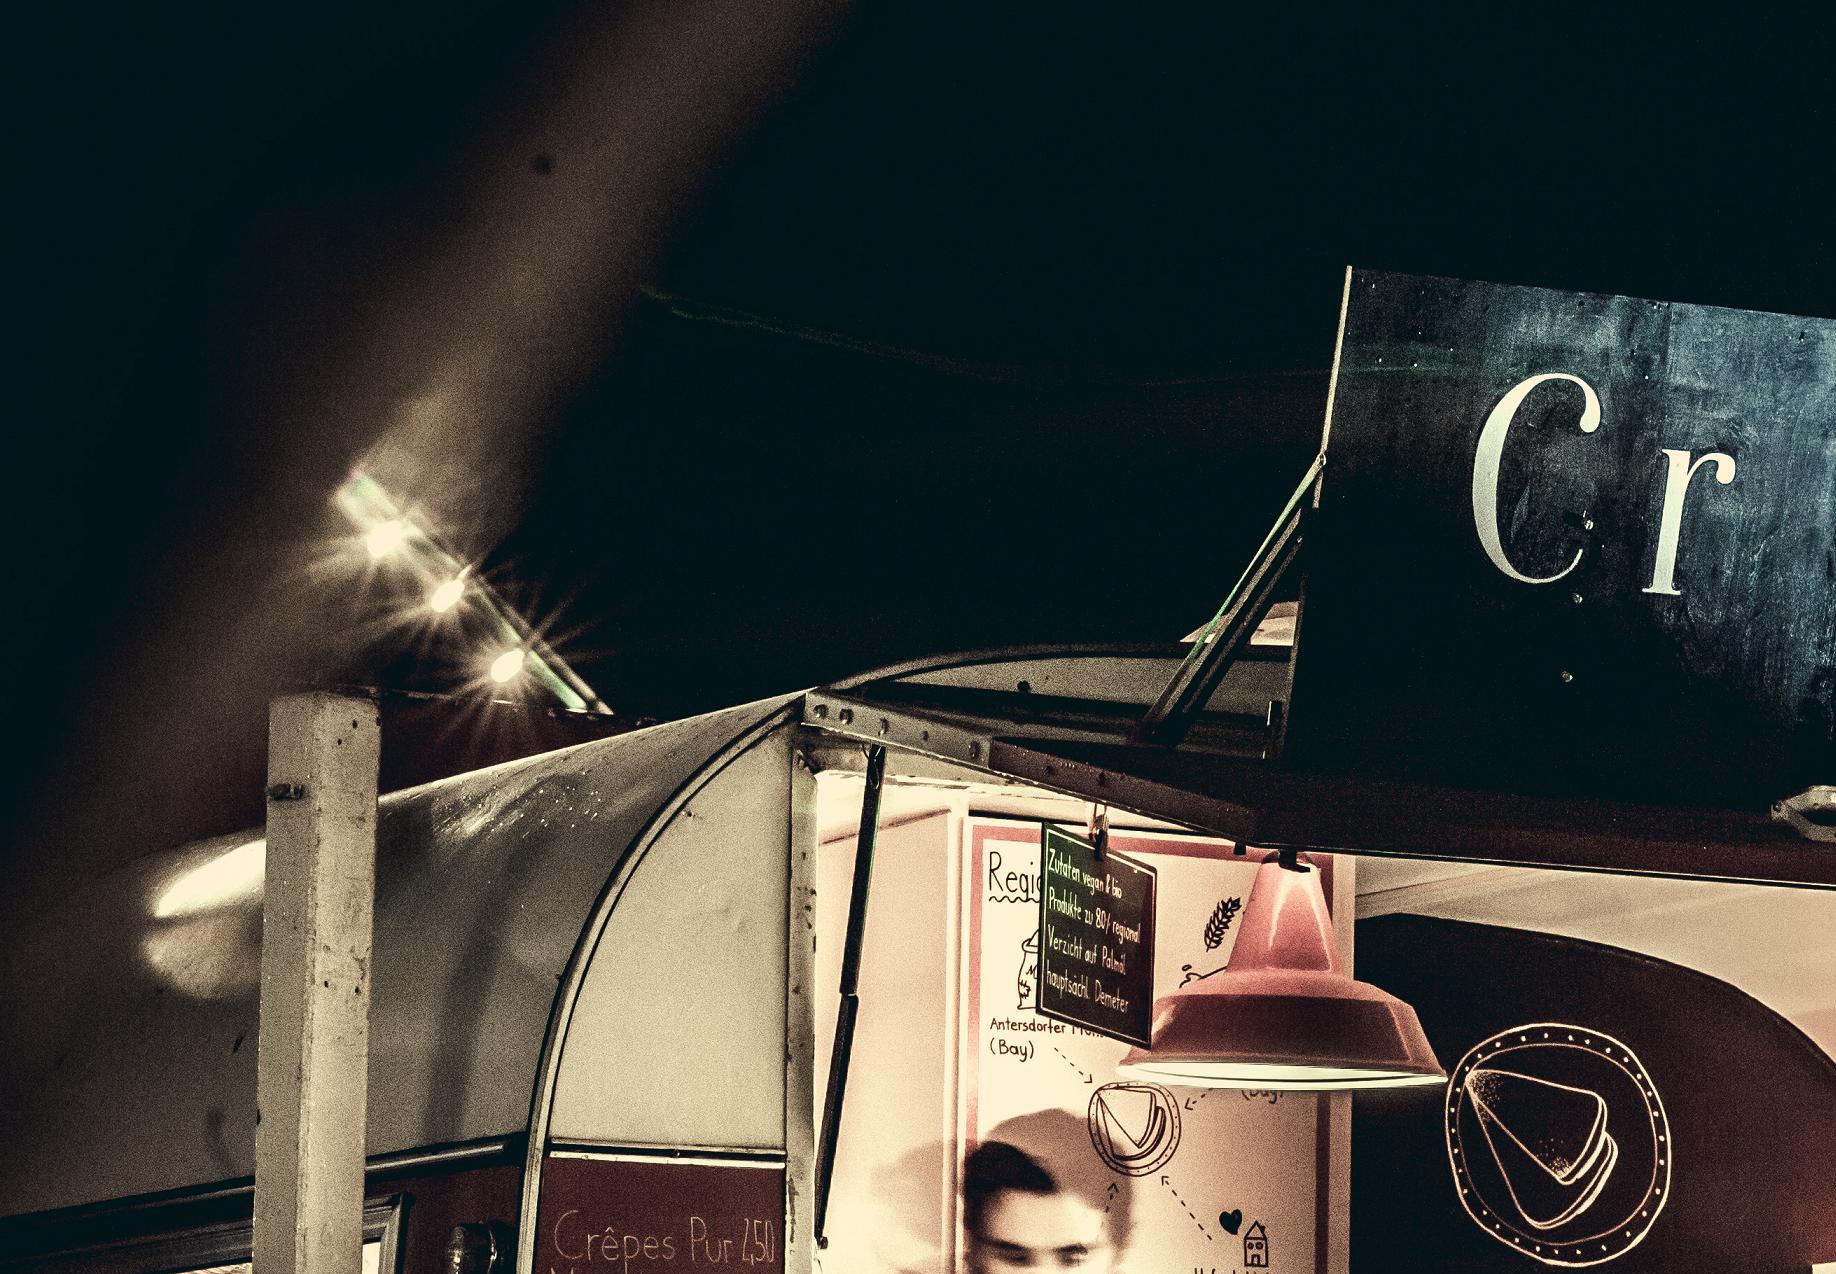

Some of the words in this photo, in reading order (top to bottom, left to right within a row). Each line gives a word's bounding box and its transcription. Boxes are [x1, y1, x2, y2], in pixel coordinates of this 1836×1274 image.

[1048, 848, 1080, 883] Zutaten
[1082, 872, 1104, 895] vegan
[1112, 877, 1122, 899] bio
[1048, 886, 1081, 921] Produkte
[1085, 909, 1093, 925] zu
[1112, 921, 1141, 944] regional
[1048, 924, 1083, 959] Verzicht
[1085, 944, 1098, 964] auf
[1095, 980, 1129, 1013] Demeter
[990, 1017, 1066, 1034] Antersdorfer
[990, 1037, 1034, 1062] (Bay)
[554, 1209, 677, 1274] Crêpes
[690, 1216, 733, 1264] Pur
[741, 1218, 776, 1269] 2,50
